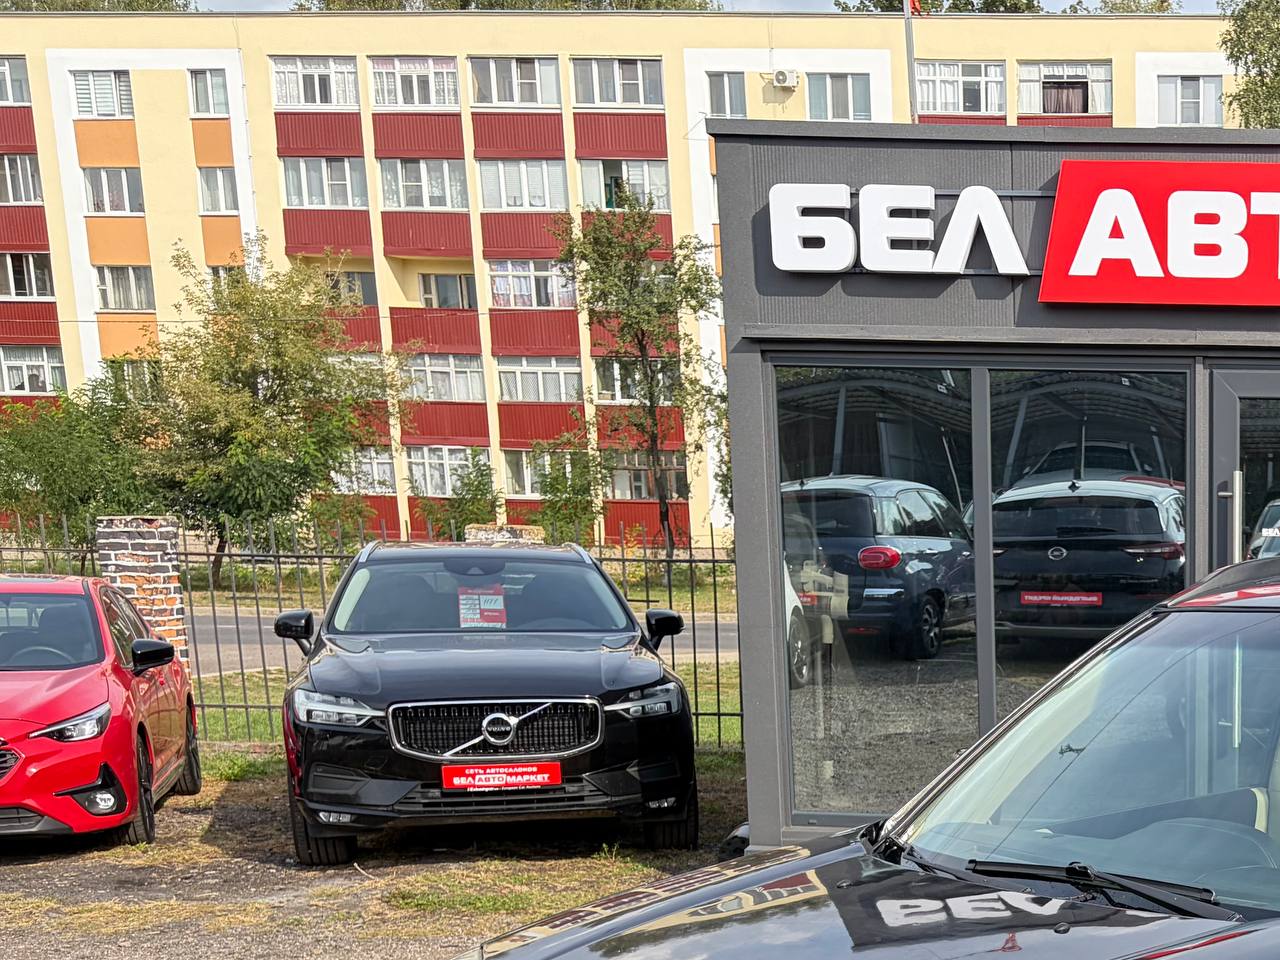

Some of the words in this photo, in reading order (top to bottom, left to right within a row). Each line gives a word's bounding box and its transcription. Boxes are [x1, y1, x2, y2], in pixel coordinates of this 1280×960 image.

[767, 183, 1031, 276] БЕЛ
[485, 766, 538, 774] АВТОСАЛОНОВ
[452, 776, 475, 785] БЕЛ
[477, 775, 505, 784] АВТО
[506, 773, 550, 784] МАРКЕТ
